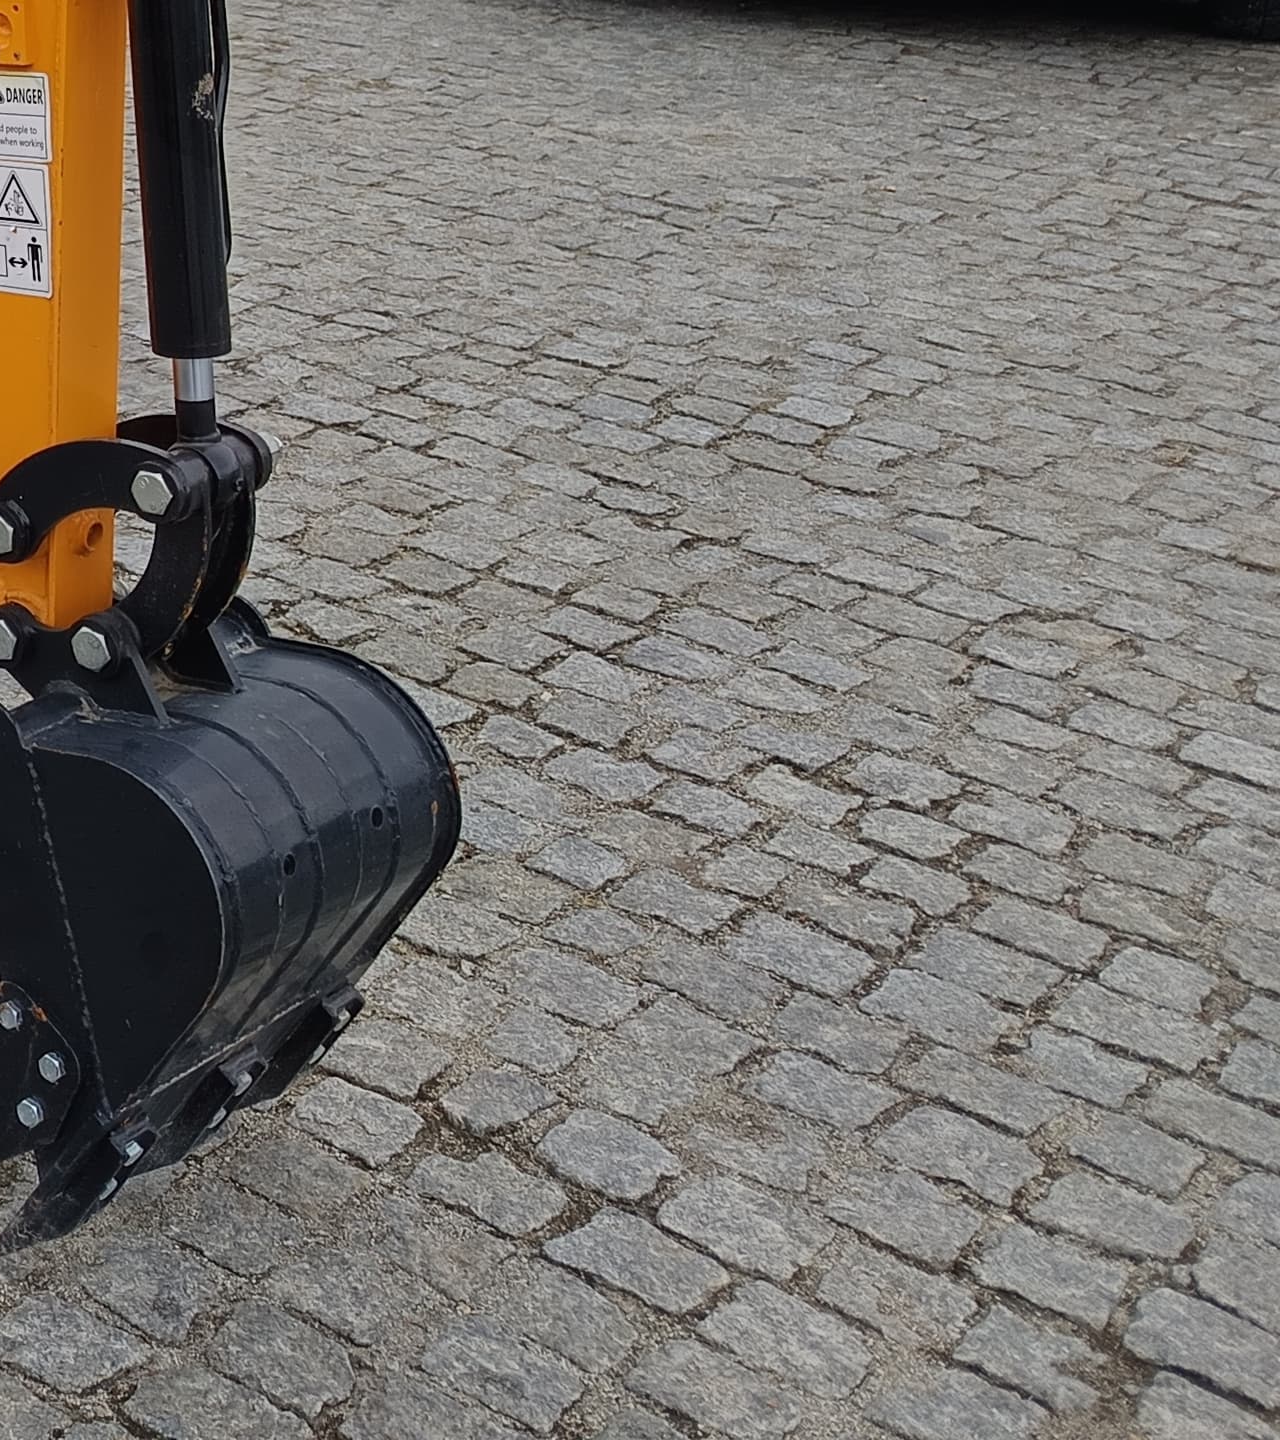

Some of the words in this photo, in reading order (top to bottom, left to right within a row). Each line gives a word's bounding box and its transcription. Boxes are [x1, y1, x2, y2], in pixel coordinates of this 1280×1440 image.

[6, 87, 43, 105] DANGER
[5, 123, 28, 136] people
[29, 126, 37, 135] to
[0, 136, 18, 146] when
[19, 138, 44, 151] working
